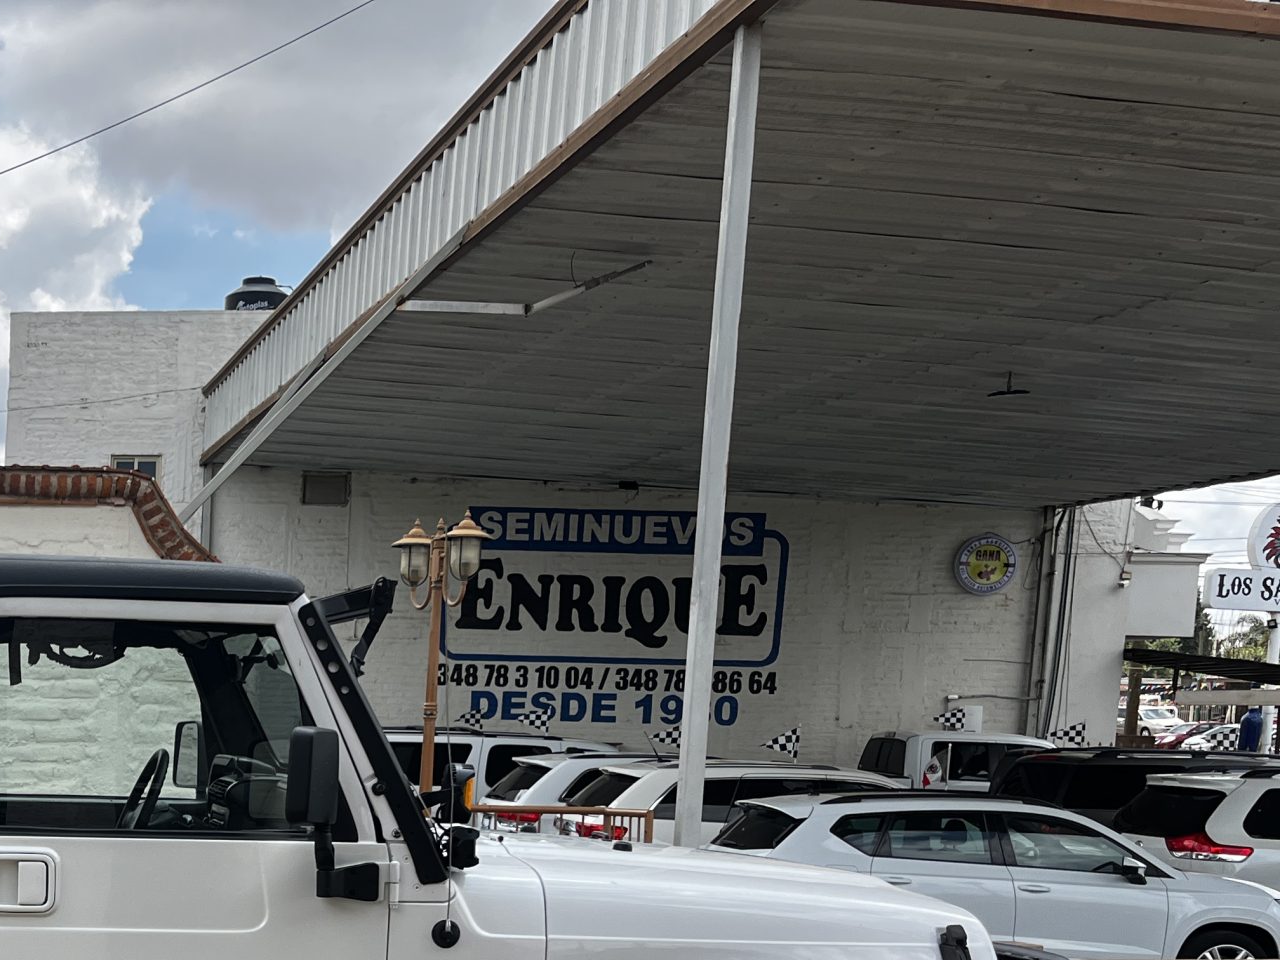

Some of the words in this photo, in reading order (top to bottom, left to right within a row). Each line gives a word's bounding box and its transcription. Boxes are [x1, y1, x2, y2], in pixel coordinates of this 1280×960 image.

[479, 510, 754, 547] SEMINUEVS
[975, 549, 1000, 562] GANA
[1216, 573, 1253, 599] LOS
[437, 663, 478, 687] 348
[484, 664, 509, 688] 78
[515, 665, 529, 689] 3
[535, 666, 560, 690] 10
[565, 666, 594, 690] 04
[615, 667, 659, 692] 348
[664, 669, 686, 693] 78
[711, 670, 743, 695] 86
[749, 671, 778, 696] 64
[470, 690, 617, 723] DESDE
[634, 694, 739, 727] 190
